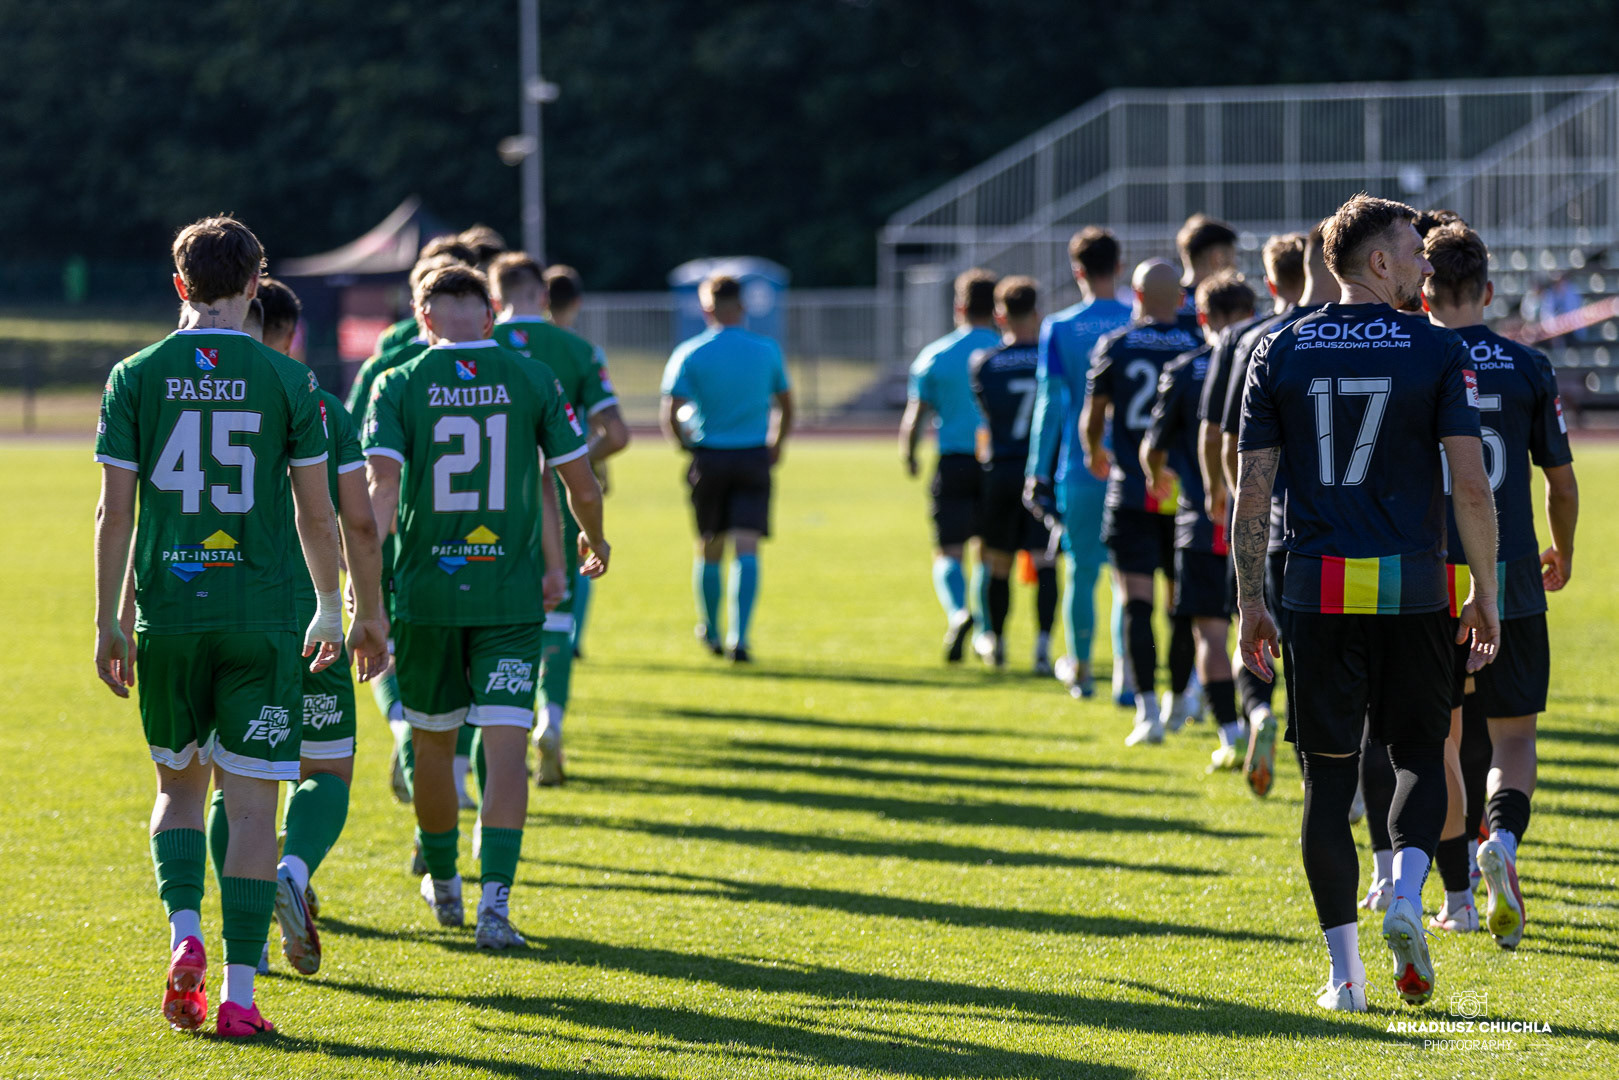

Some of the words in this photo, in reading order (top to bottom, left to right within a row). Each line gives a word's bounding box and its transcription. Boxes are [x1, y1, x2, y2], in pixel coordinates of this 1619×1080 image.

[1297, 317, 1411, 341] SOKÓŁ
[1294, 341, 1370, 351] KOLBUSZOWA
[1372, 340, 1411, 348] DOLNA
[1480, 361, 1514, 370] DOLNA
[165, 374, 247, 401] PAŚKO
[427, 383, 512, 407] ŻMUDA
[1307, 377, 1392, 486] 17
[150, 409, 263, 514] 45
[432, 413, 508, 513] 21
[162, 550, 244, 562] PAT-INSTAL
[431, 545, 505, 557] PAT-INSTAL
